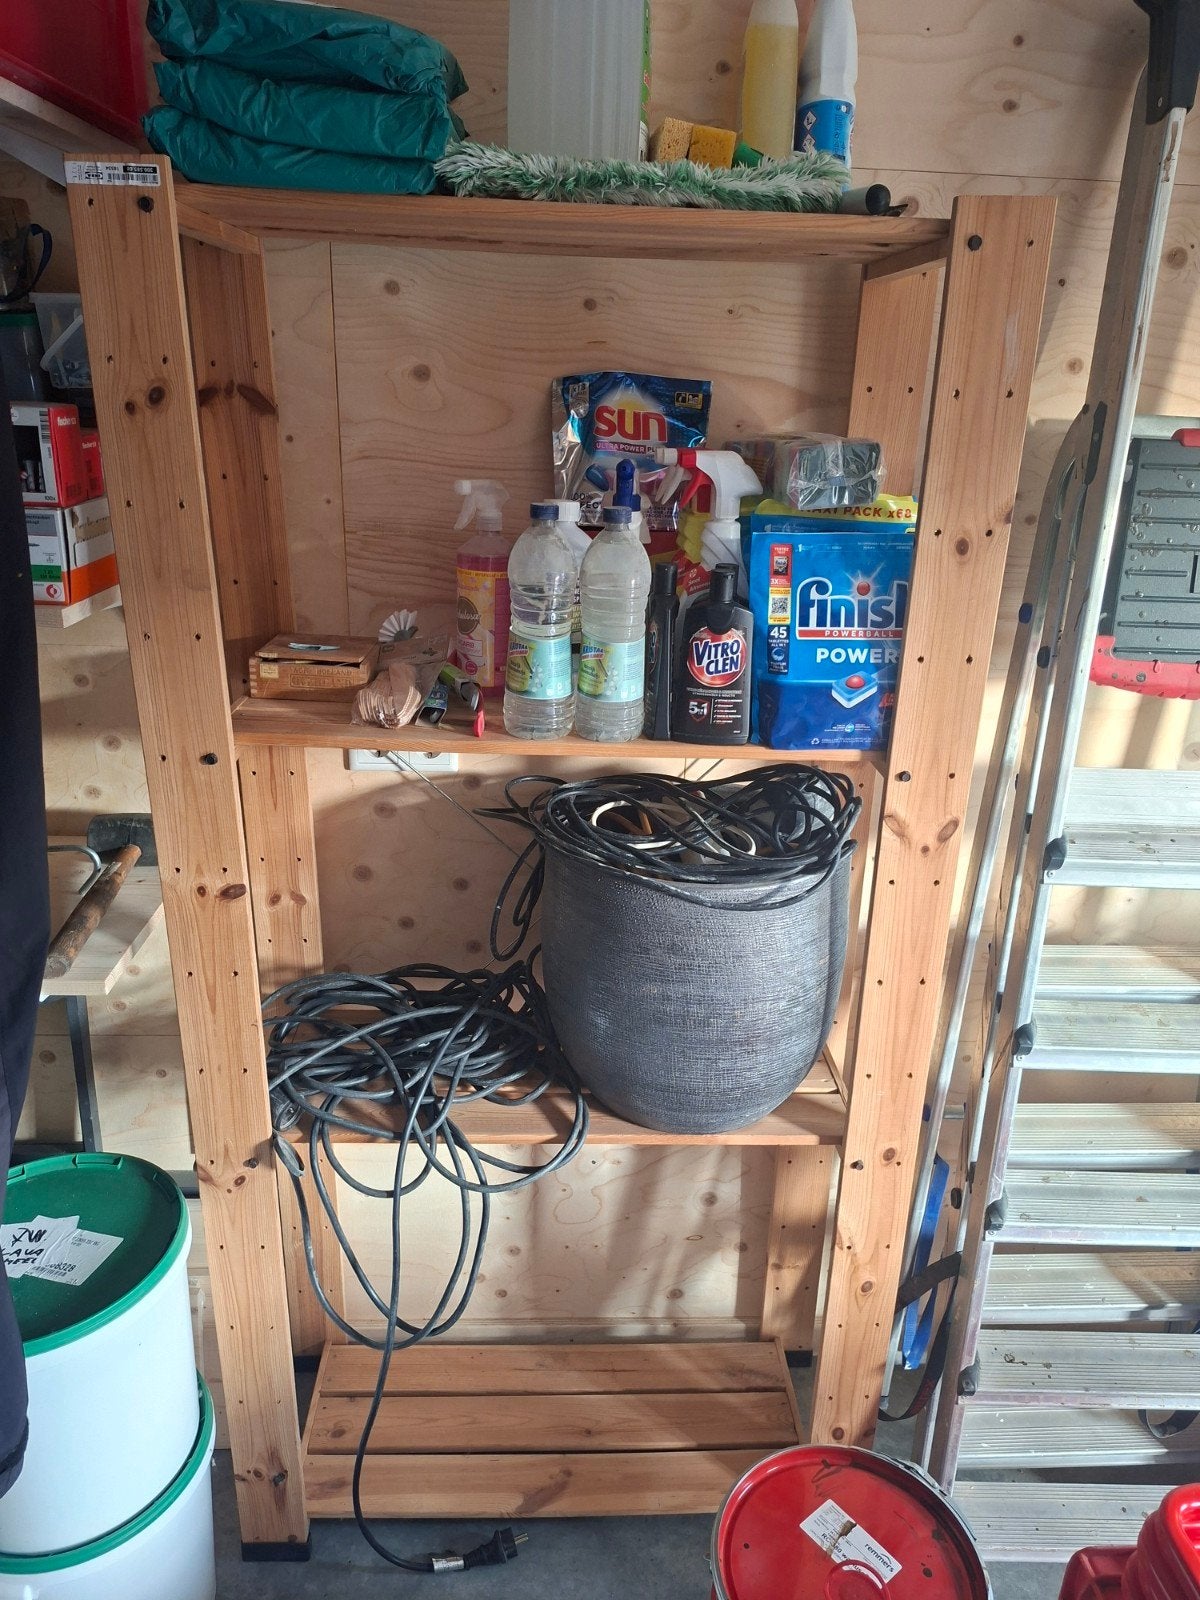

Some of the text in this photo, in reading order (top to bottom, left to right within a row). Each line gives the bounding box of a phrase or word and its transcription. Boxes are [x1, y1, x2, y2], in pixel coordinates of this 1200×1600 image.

[593, 405, 668, 443] sun
[596, 442, 619, 450] ULTRA
[619, 444, 646, 454] POWER
[843, 506, 883, 518] PACK
[888, 509, 912, 519] x68
[770, 627, 788, 639] 45
[824, 630, 894, 638] POWERBALL
[693, 638, 742, 667] VITRO
[816, 647, 898, 663] POWER
[704, 653, 741, 676] CLEN
[864, 1543, 895, 1573] remmers
